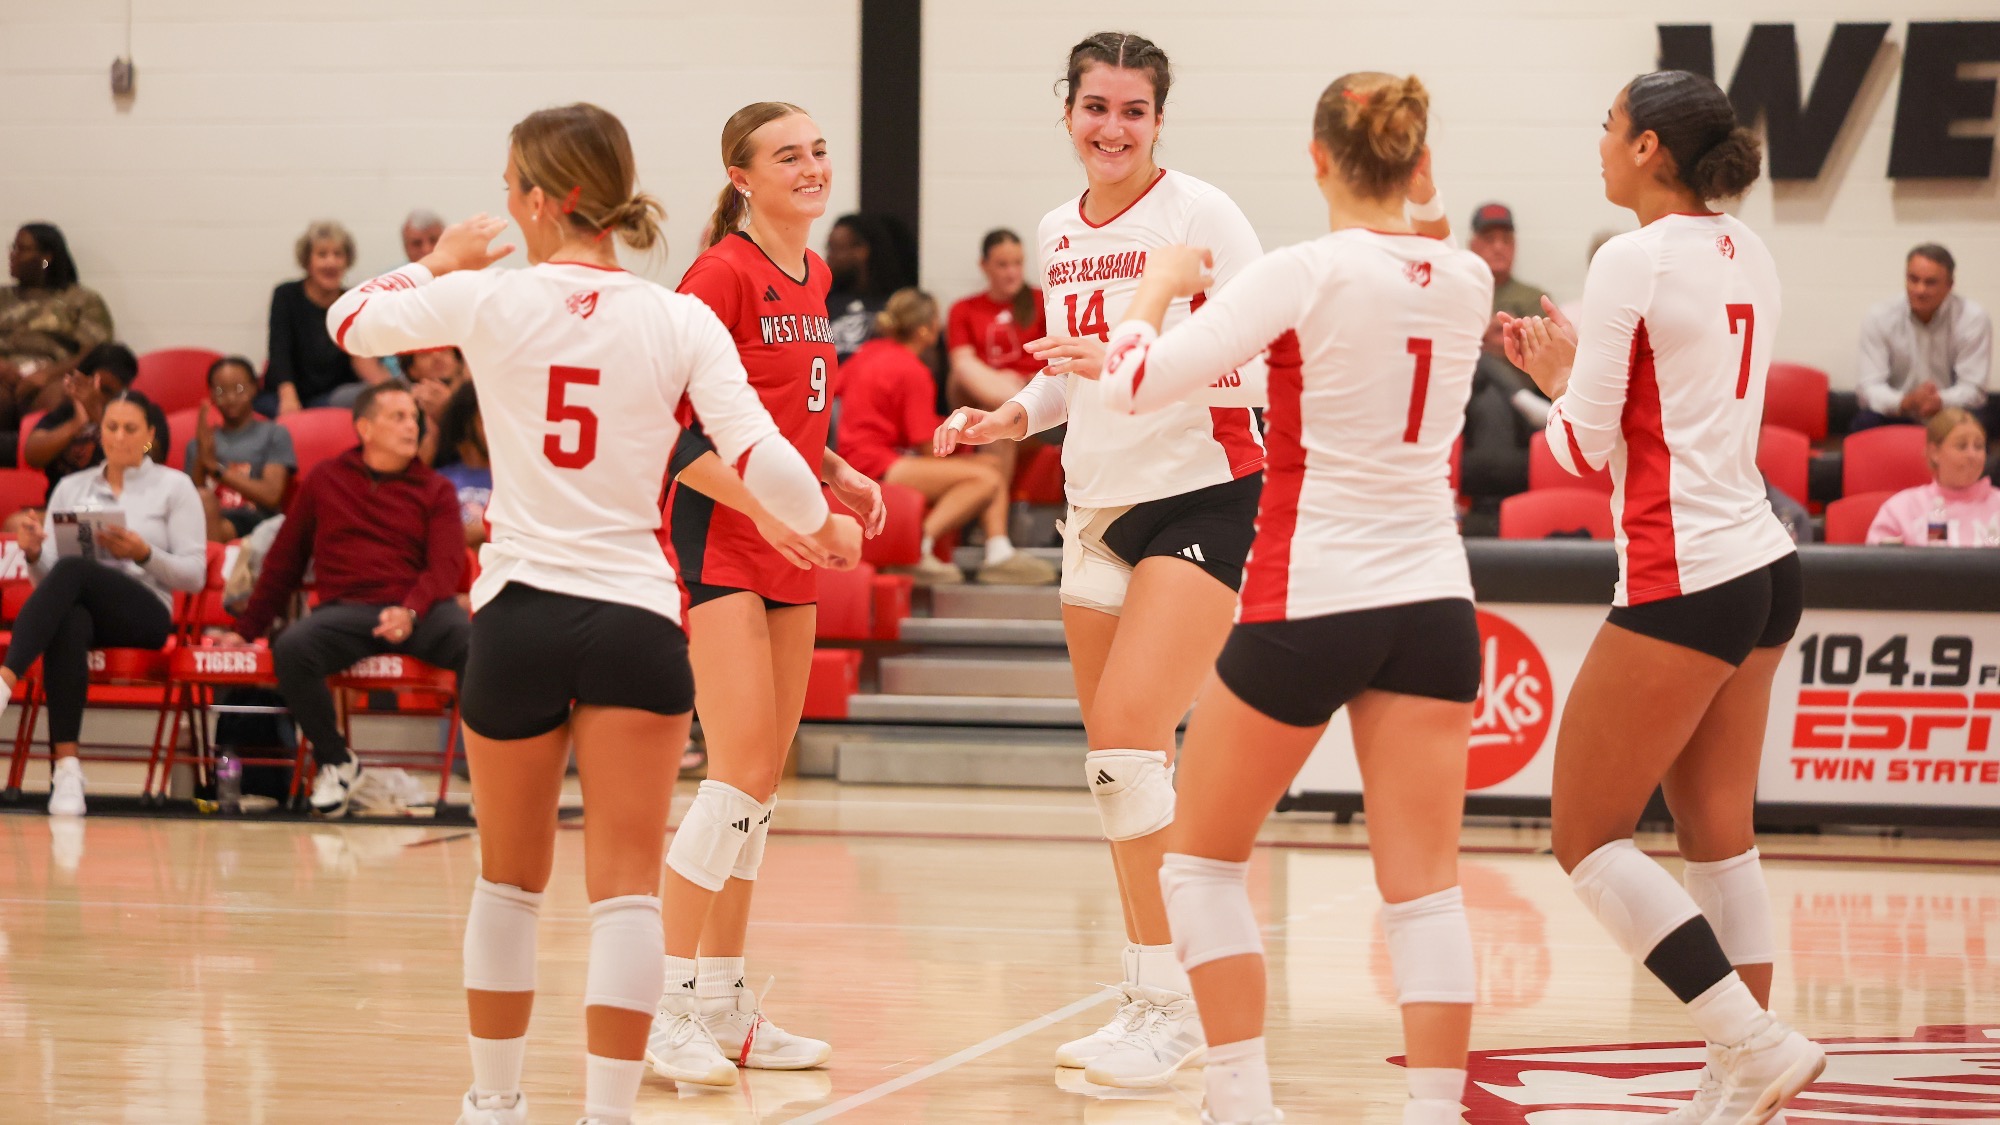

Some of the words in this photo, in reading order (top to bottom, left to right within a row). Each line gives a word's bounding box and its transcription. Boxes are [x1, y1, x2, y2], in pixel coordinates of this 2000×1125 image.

[1048, 259, 1078, 288] WEST
[1077, 251, 1147, 282] ALABAMA
[760, 315, 800, 344] WEST
[1064, 289, 1110, 343] 14
[1725, 303, 1755, 399] 7
[807, 356, 827, 412] 9
[1404, 337, 1433, 443] 1
[543, 365, 600, 469] 5
[193, 652, 257, 673] TIGERS
[1799, 632, 1974, 687] 104.9
[1978, 665, 2000, 686] F
[1790, 757, 1875, 781] TWIN
